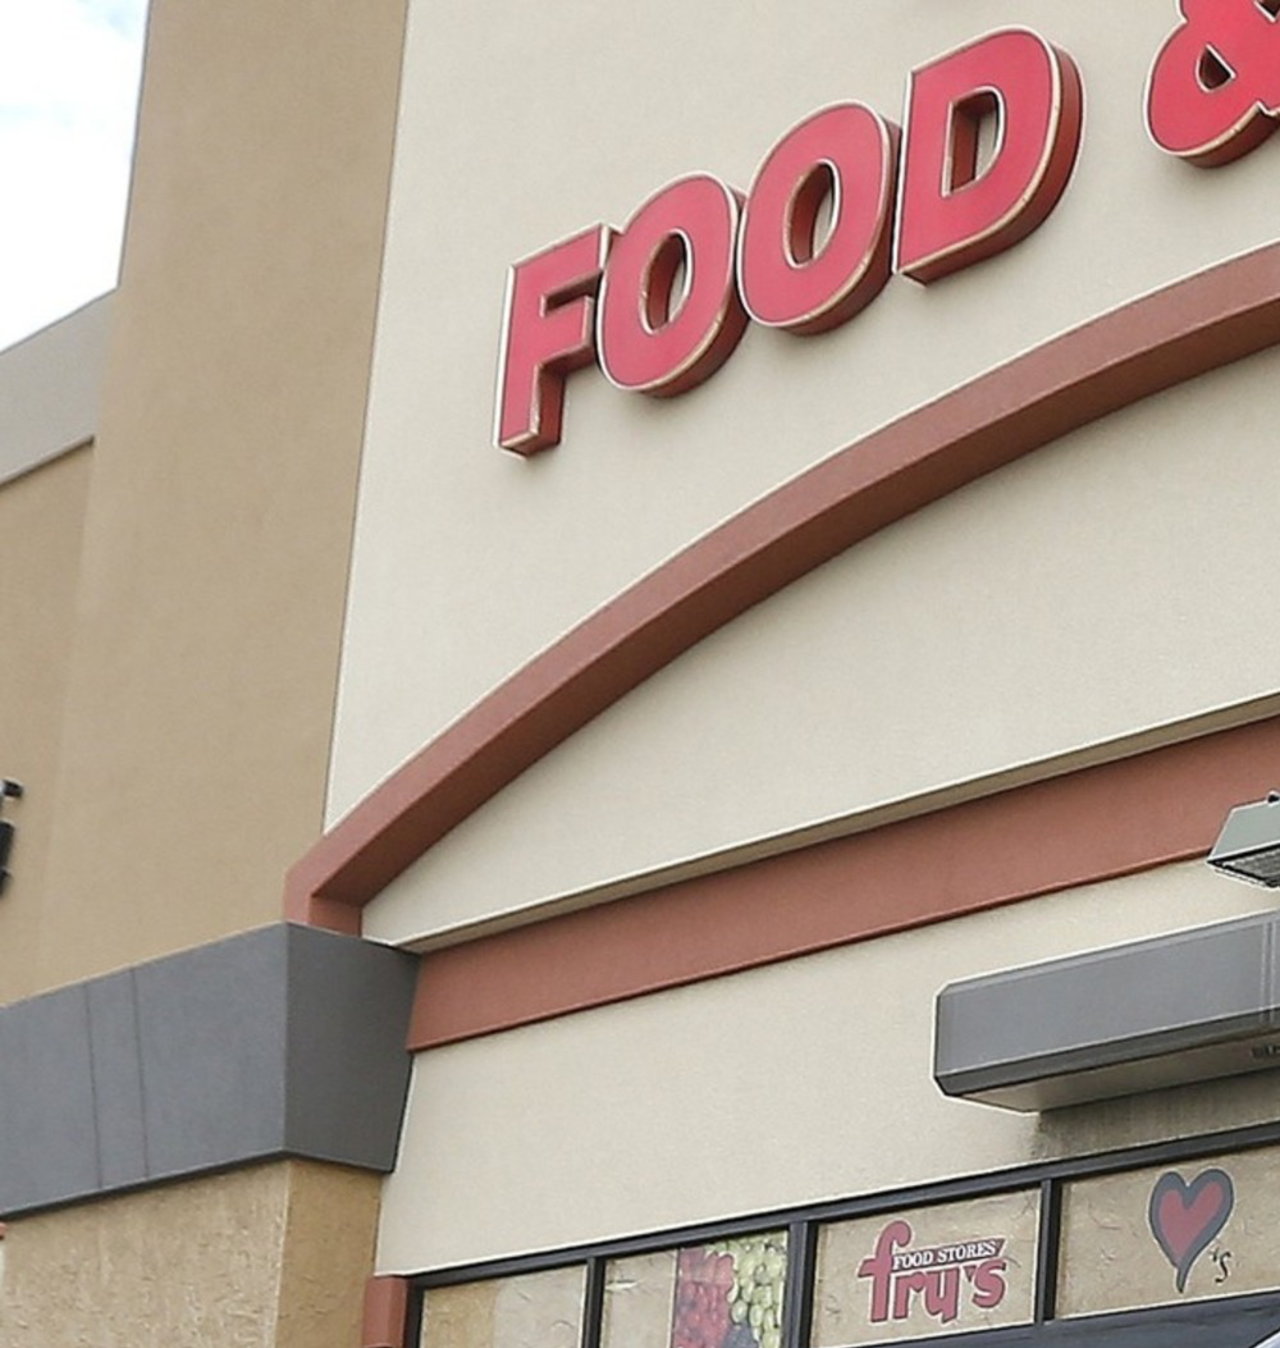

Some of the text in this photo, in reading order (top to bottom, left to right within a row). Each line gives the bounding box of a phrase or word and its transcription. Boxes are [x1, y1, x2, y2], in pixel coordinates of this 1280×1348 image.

[492, 23, 1085, 459] FOOD
[857, 1219, 1007, 1324] fry's
[892, 1239, 998, 1271] FOOD STORES
